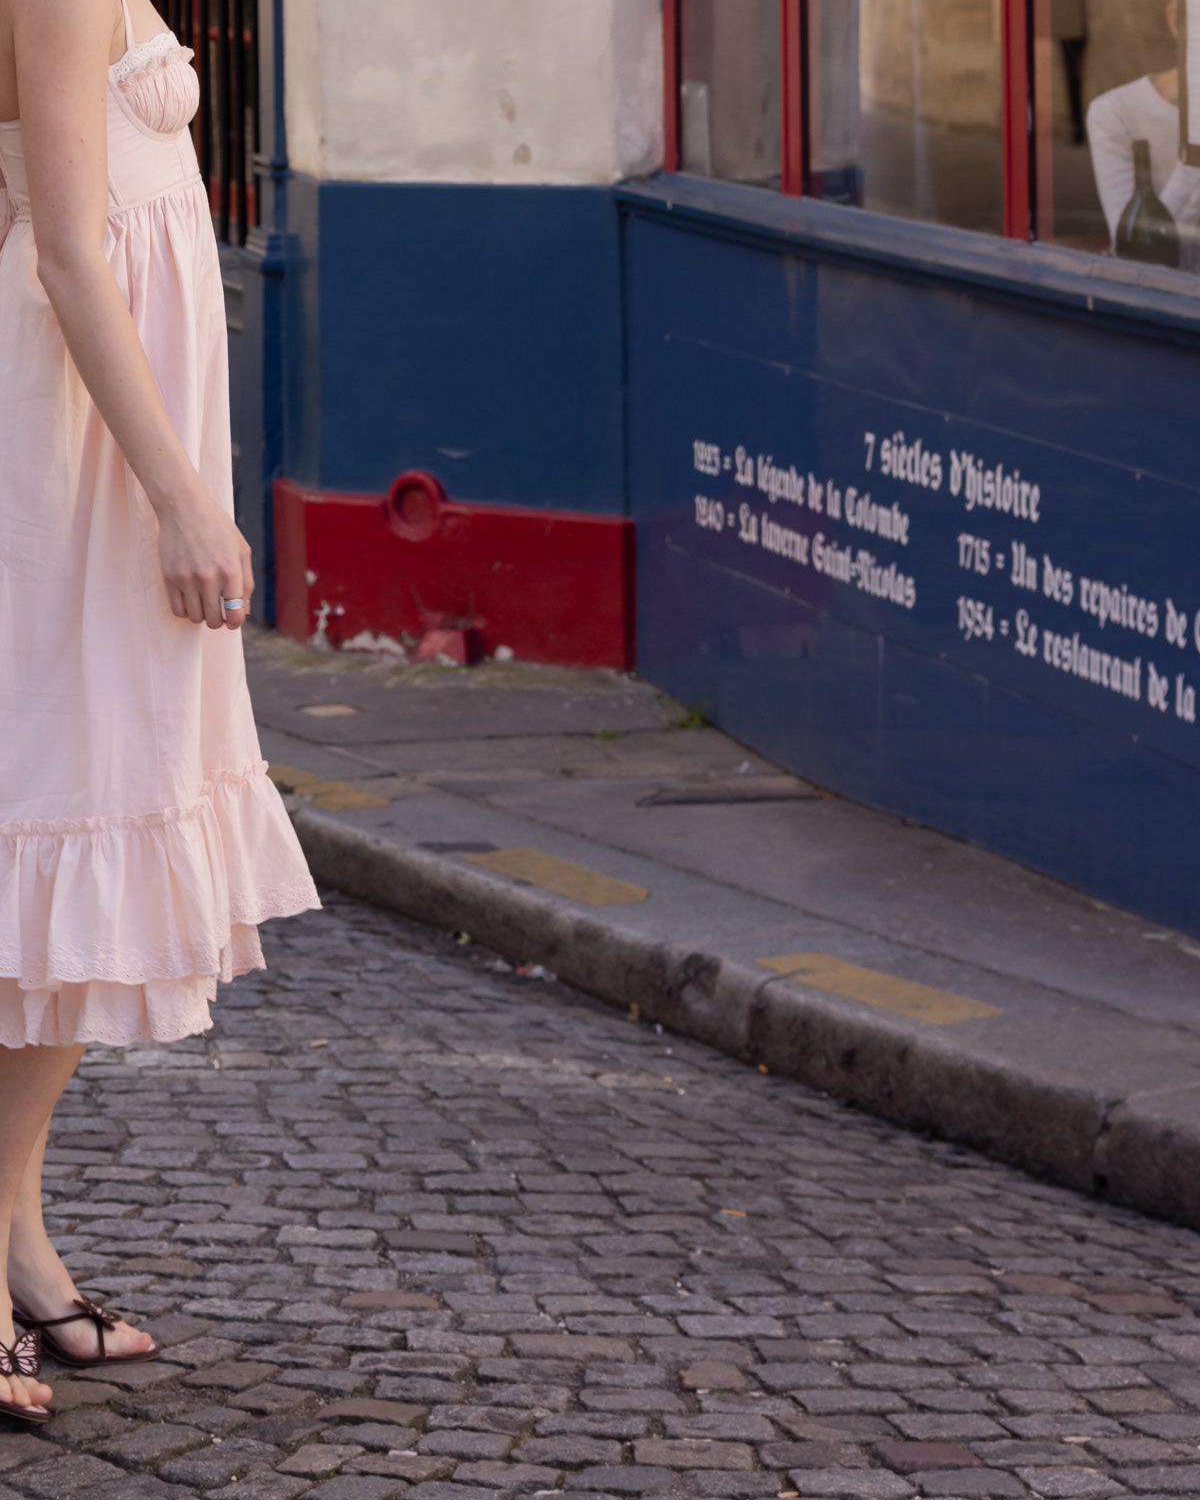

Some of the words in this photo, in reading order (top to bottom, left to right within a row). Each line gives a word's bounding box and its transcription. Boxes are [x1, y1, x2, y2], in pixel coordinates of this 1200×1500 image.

[734, 445, 754, 487] La
[757, 453, 804, 506] légende
[808, 471, 823, 514] de
[826, 478, 841, 520] la
[845, 486, 910, 546] Colombe
[864, 431, 875, 472] 7
[880, 430, 942, 491] siècles
[950, 448, 1041, 524] d'histoire
[738, 502, 758, 544] La
[761, 511, 809, 566] taverne
[957, 532, 990, 576] 1715
[1010, 539, 1037, 592] Un
[1043, 553, 1073, 606] des
[1080, 576, 1159, 639] repaires
[1166, 598, 1187, 649] de
[957, 595, 995, 642] 1954
[1014, 608, 1038, 658] Le
[1043, 629, 1142, 701] restaurant
[1147, 661, 1169, 713] de
[1175, 672, 1196, 724] la
